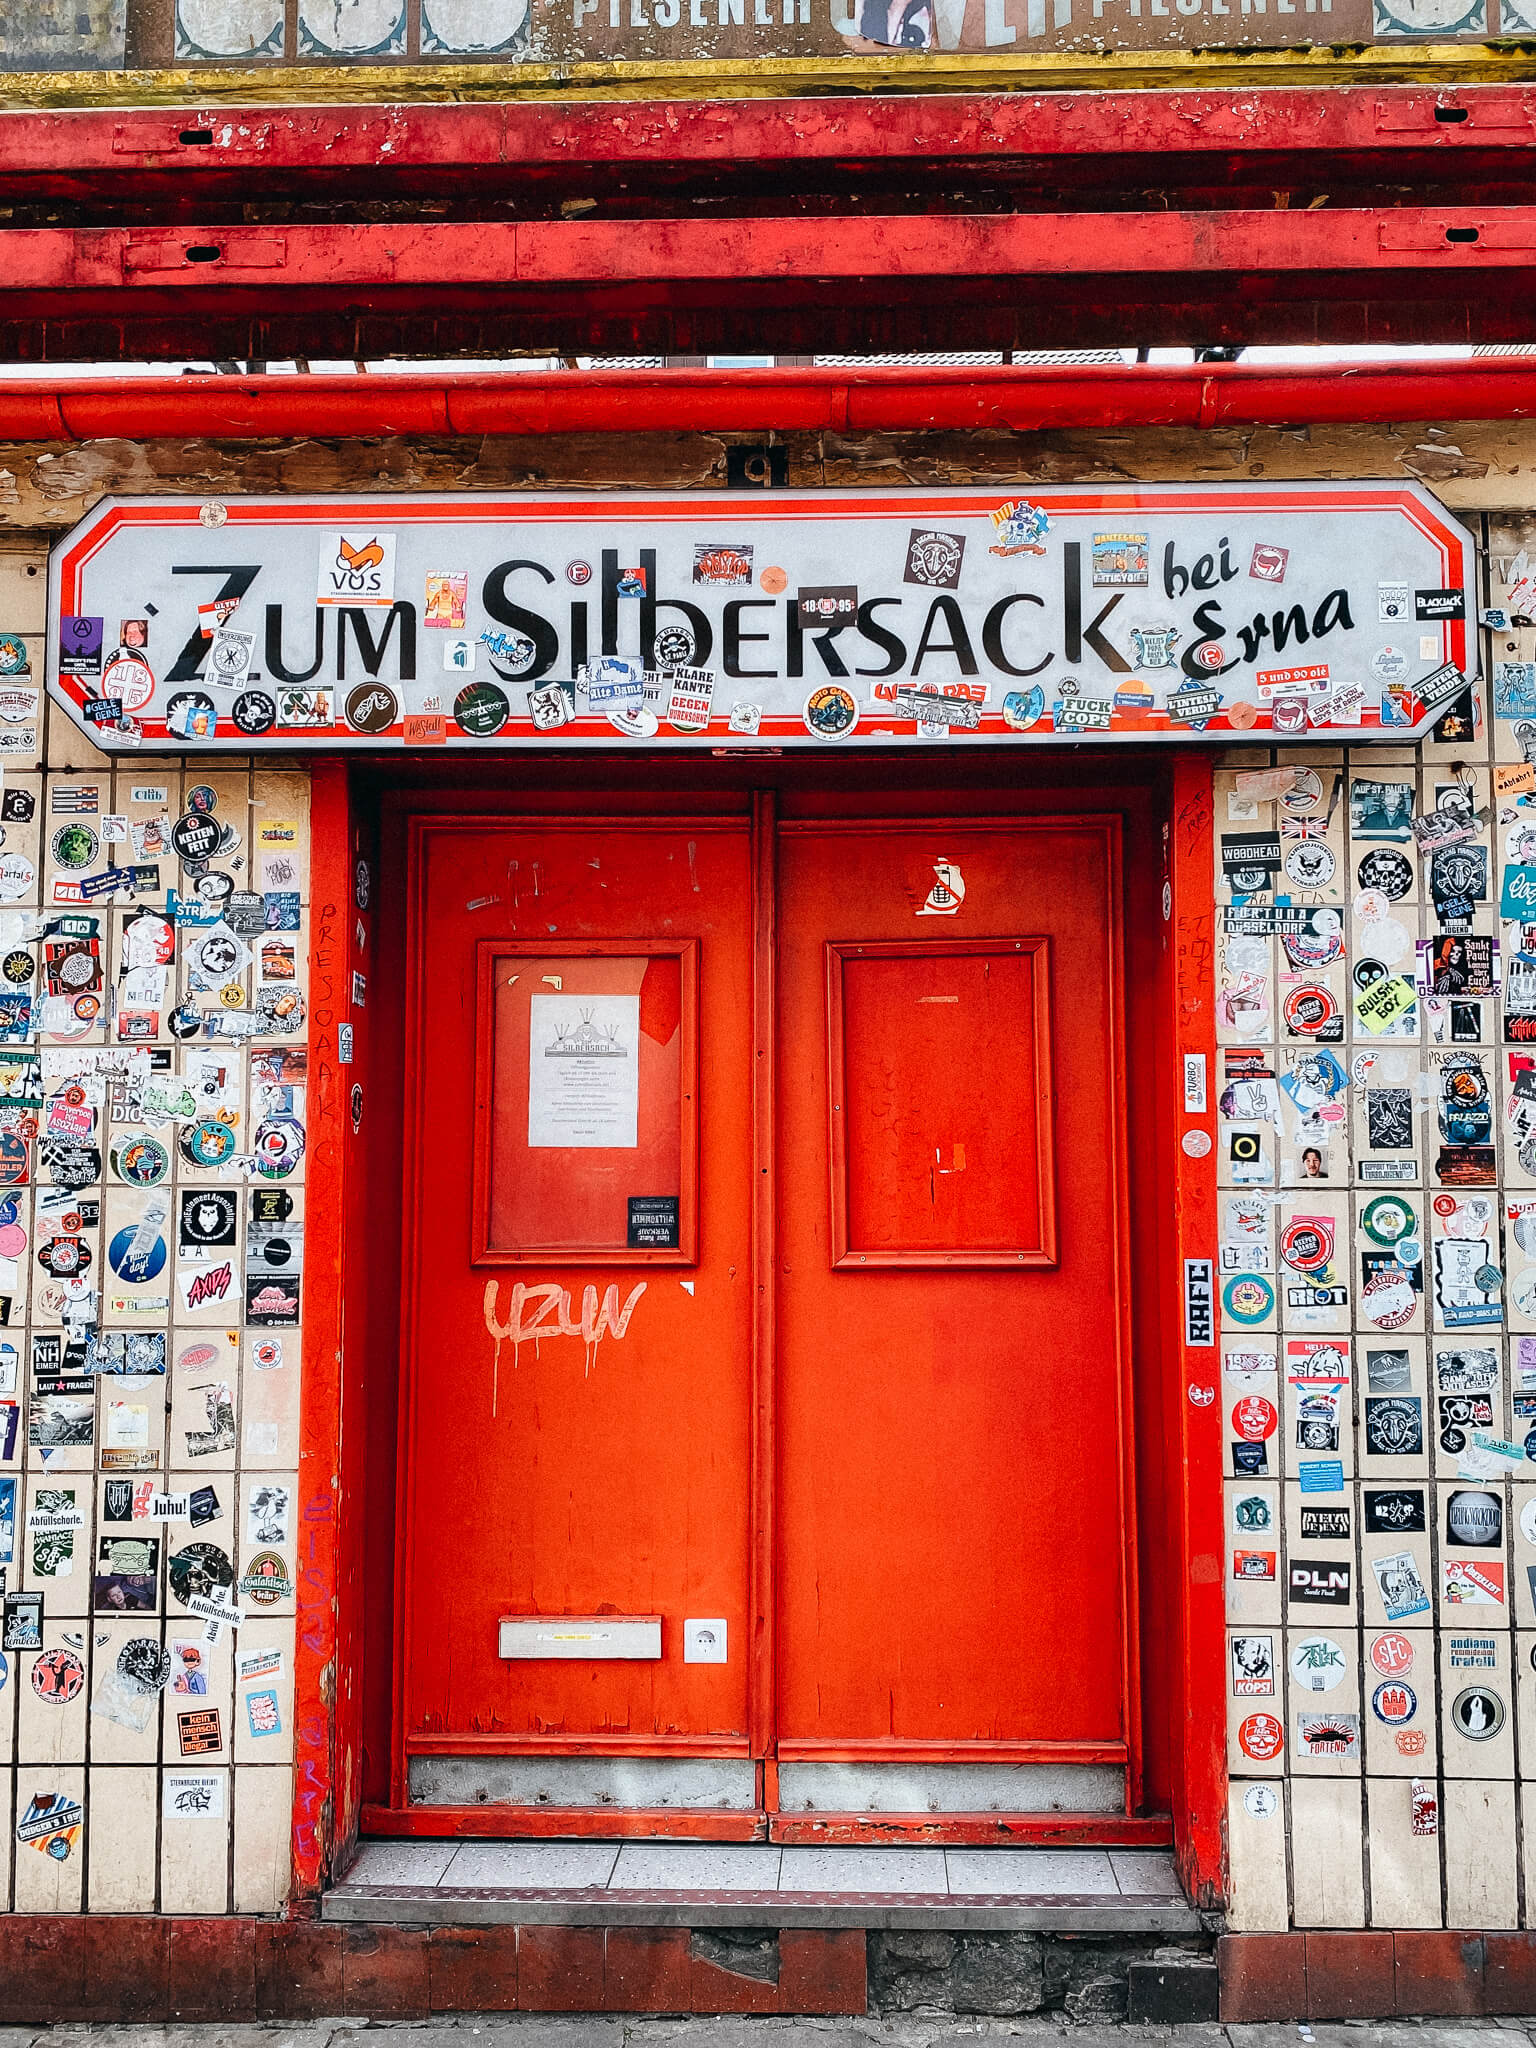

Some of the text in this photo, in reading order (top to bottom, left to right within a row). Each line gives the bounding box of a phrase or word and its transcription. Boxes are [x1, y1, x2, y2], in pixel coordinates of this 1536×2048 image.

[1164, 537, 1239, 600] bei
[330, 572, 381, 590] VOS
[1181, 589, 1354, 680] Erna
[675, 668, 714, 683] KLARE
[1259, 675, 1267, 683] 5
[674, 680, 713, 694] KANTE
[672, 696, 709, 711] GEGEN
[1065, 699, 1110, 713] FUCK
[1176, 704, 1215, 717] VERDE
[1064, 712, 1110, 726] COPS
[178, 826, 214, 845] KETTEN
[188, 840, 209, 854] FETT
[1228, 907, 1306, 920] FORTUNA
[1464, 939, 1490, 950] Sankt
[1466, 950, 1490, 961] Pauli
[1467, 976, 1490, 987] Euch!
[35, 1348, 59, 1362] NH
[36, 1362, 59, 1370] EIMER
[66, 1381, 94, 1390] FRAGEN
[153, 1499, 187, 1516] Juhu!
[30, 1515, 83, 1528] Abfüllschorle.
[1292, 1569, 1349, 1588] DLN
[191, 1600, 241, 1624] Abfüllschorle.
[1451, 1638, 1496, 1649] andiamo
[190, 1715, 210, 1723] kein
[183, 1724, 217, 1734] mensch
